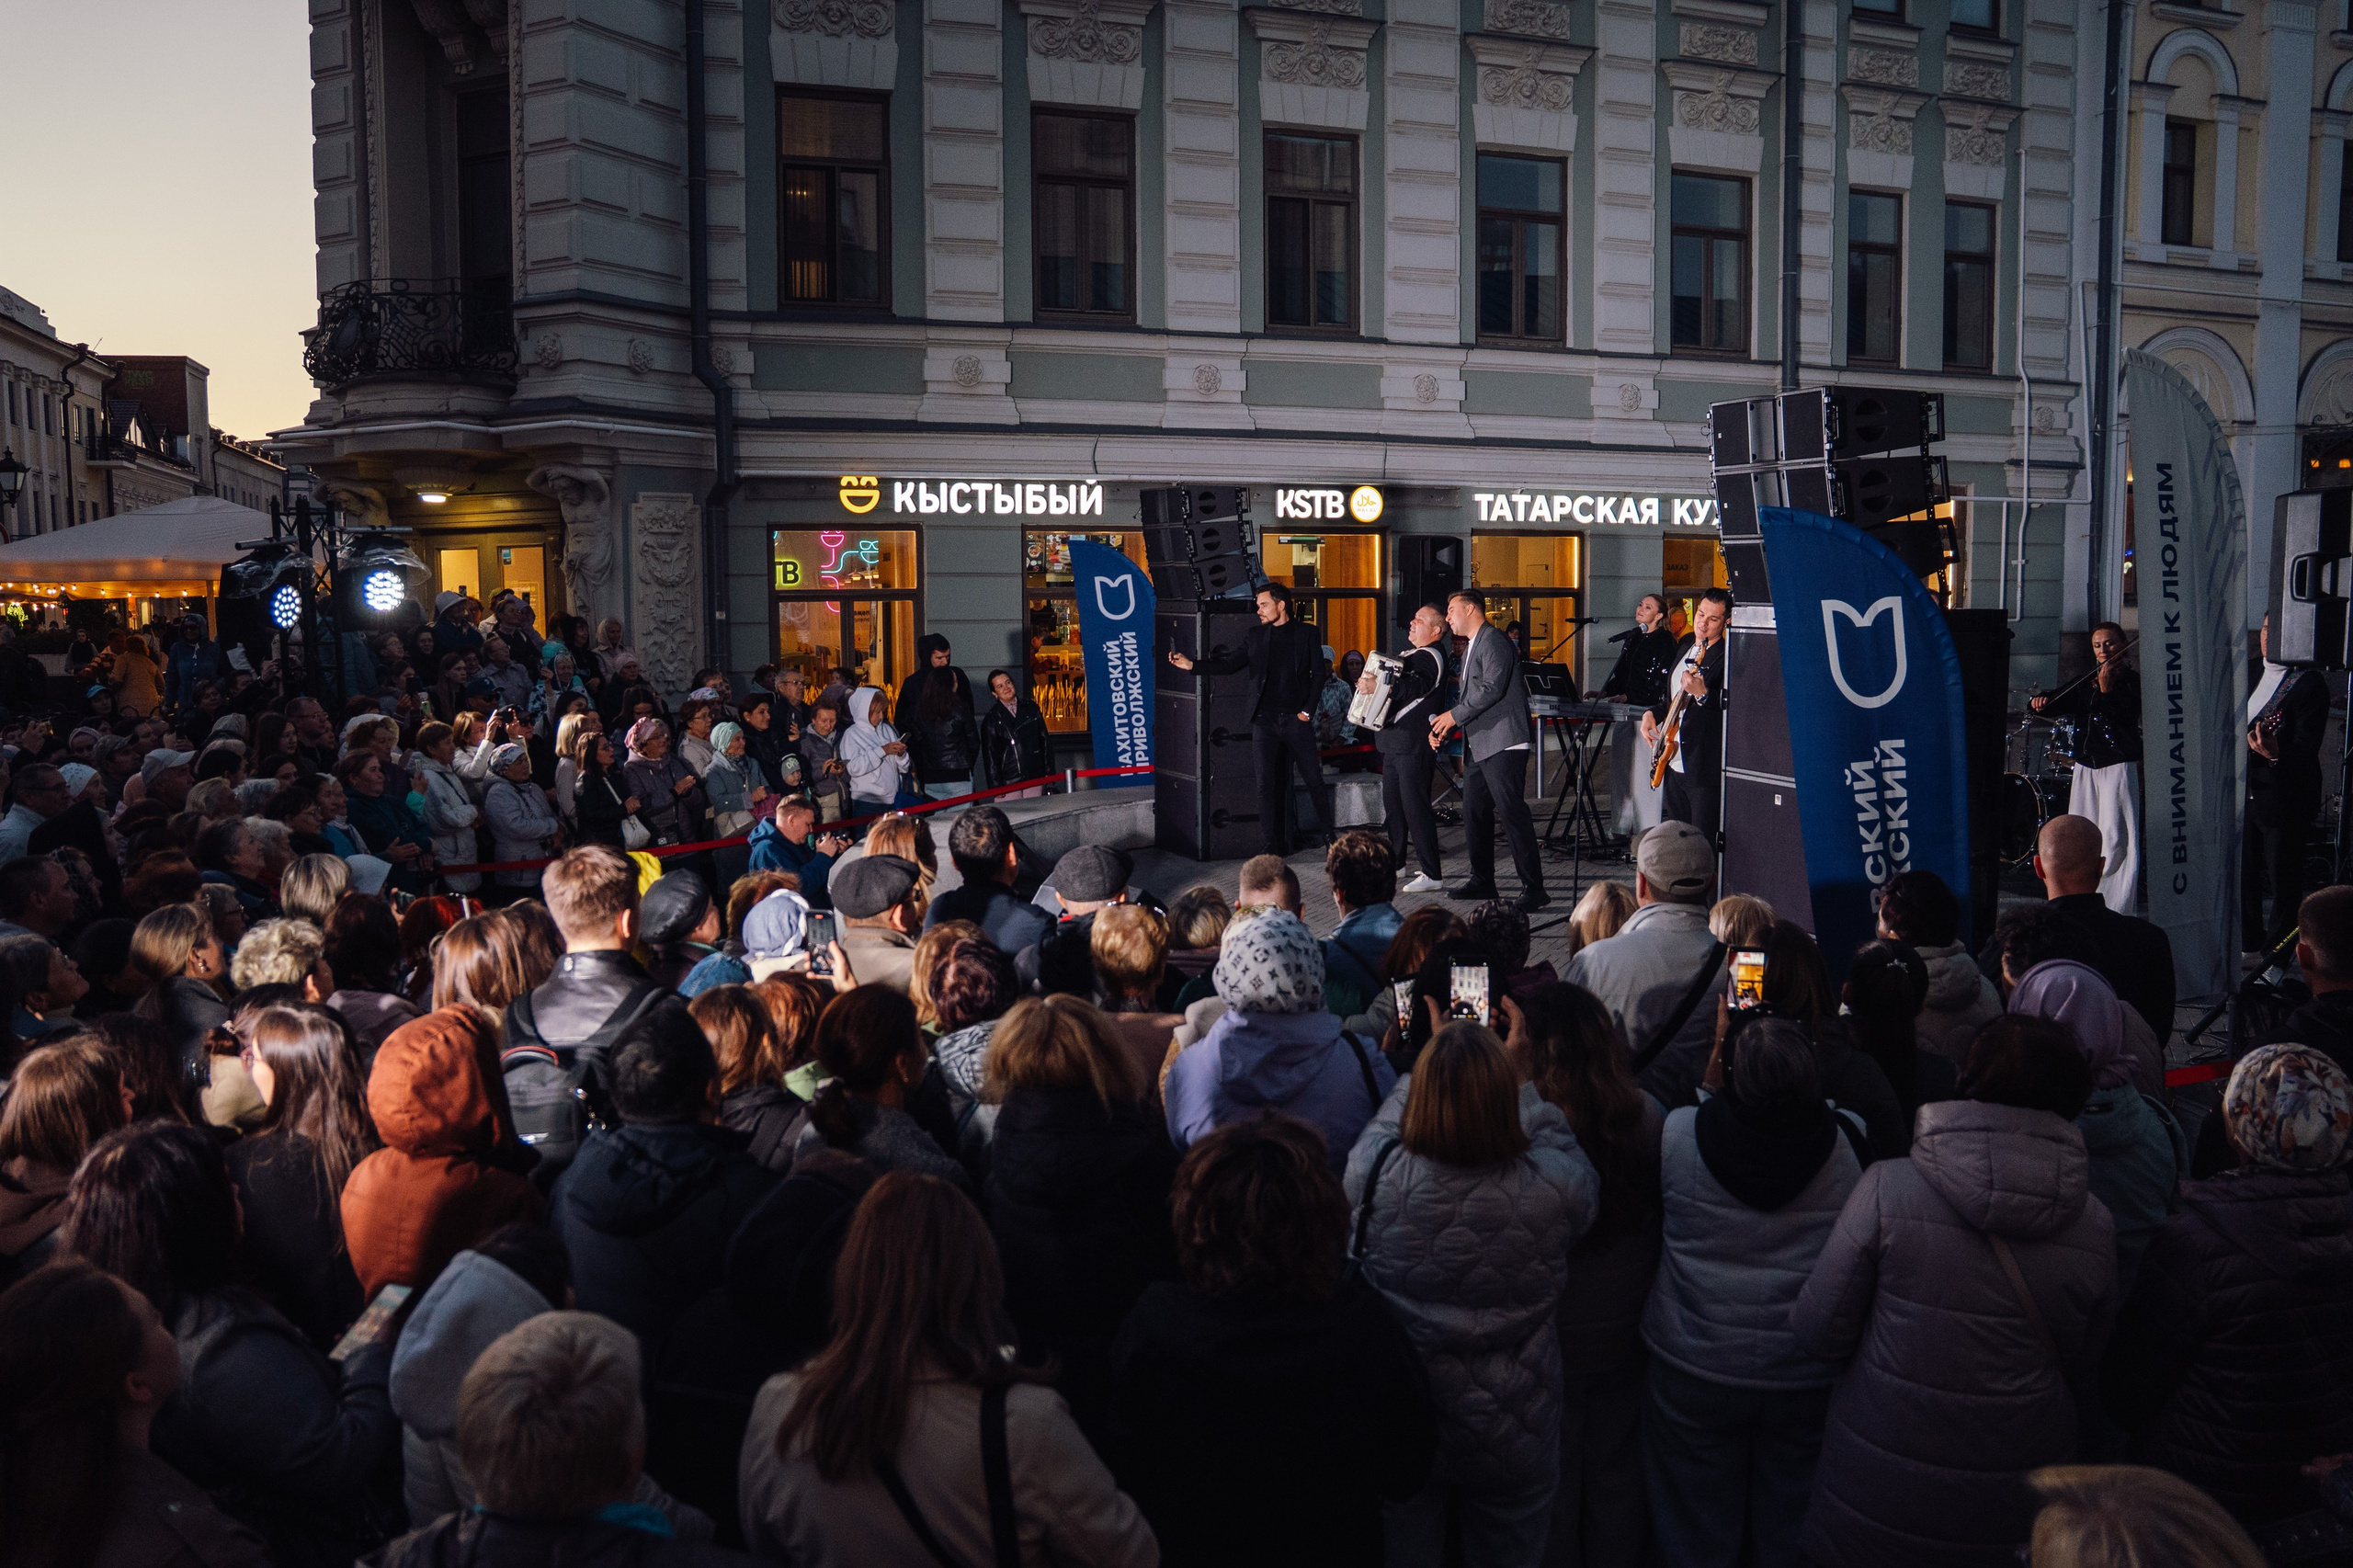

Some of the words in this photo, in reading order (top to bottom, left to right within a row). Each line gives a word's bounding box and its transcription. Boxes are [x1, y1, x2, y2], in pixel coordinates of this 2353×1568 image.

[892, 479, 1104, 516] КЫСТЫБЫЙ
[1276, 489, 1345, 519] KSTB
[1473, 494, 1659, 525] ТАТАРСКАЯ
[2156, 462, 2179, 603] ЛЮДЯМ
[2164, 610, 2181, 633] К
[2165, 642, 2188, 864] ВНИМАНИЕМ
[2173, 872, 2188, 895] С
